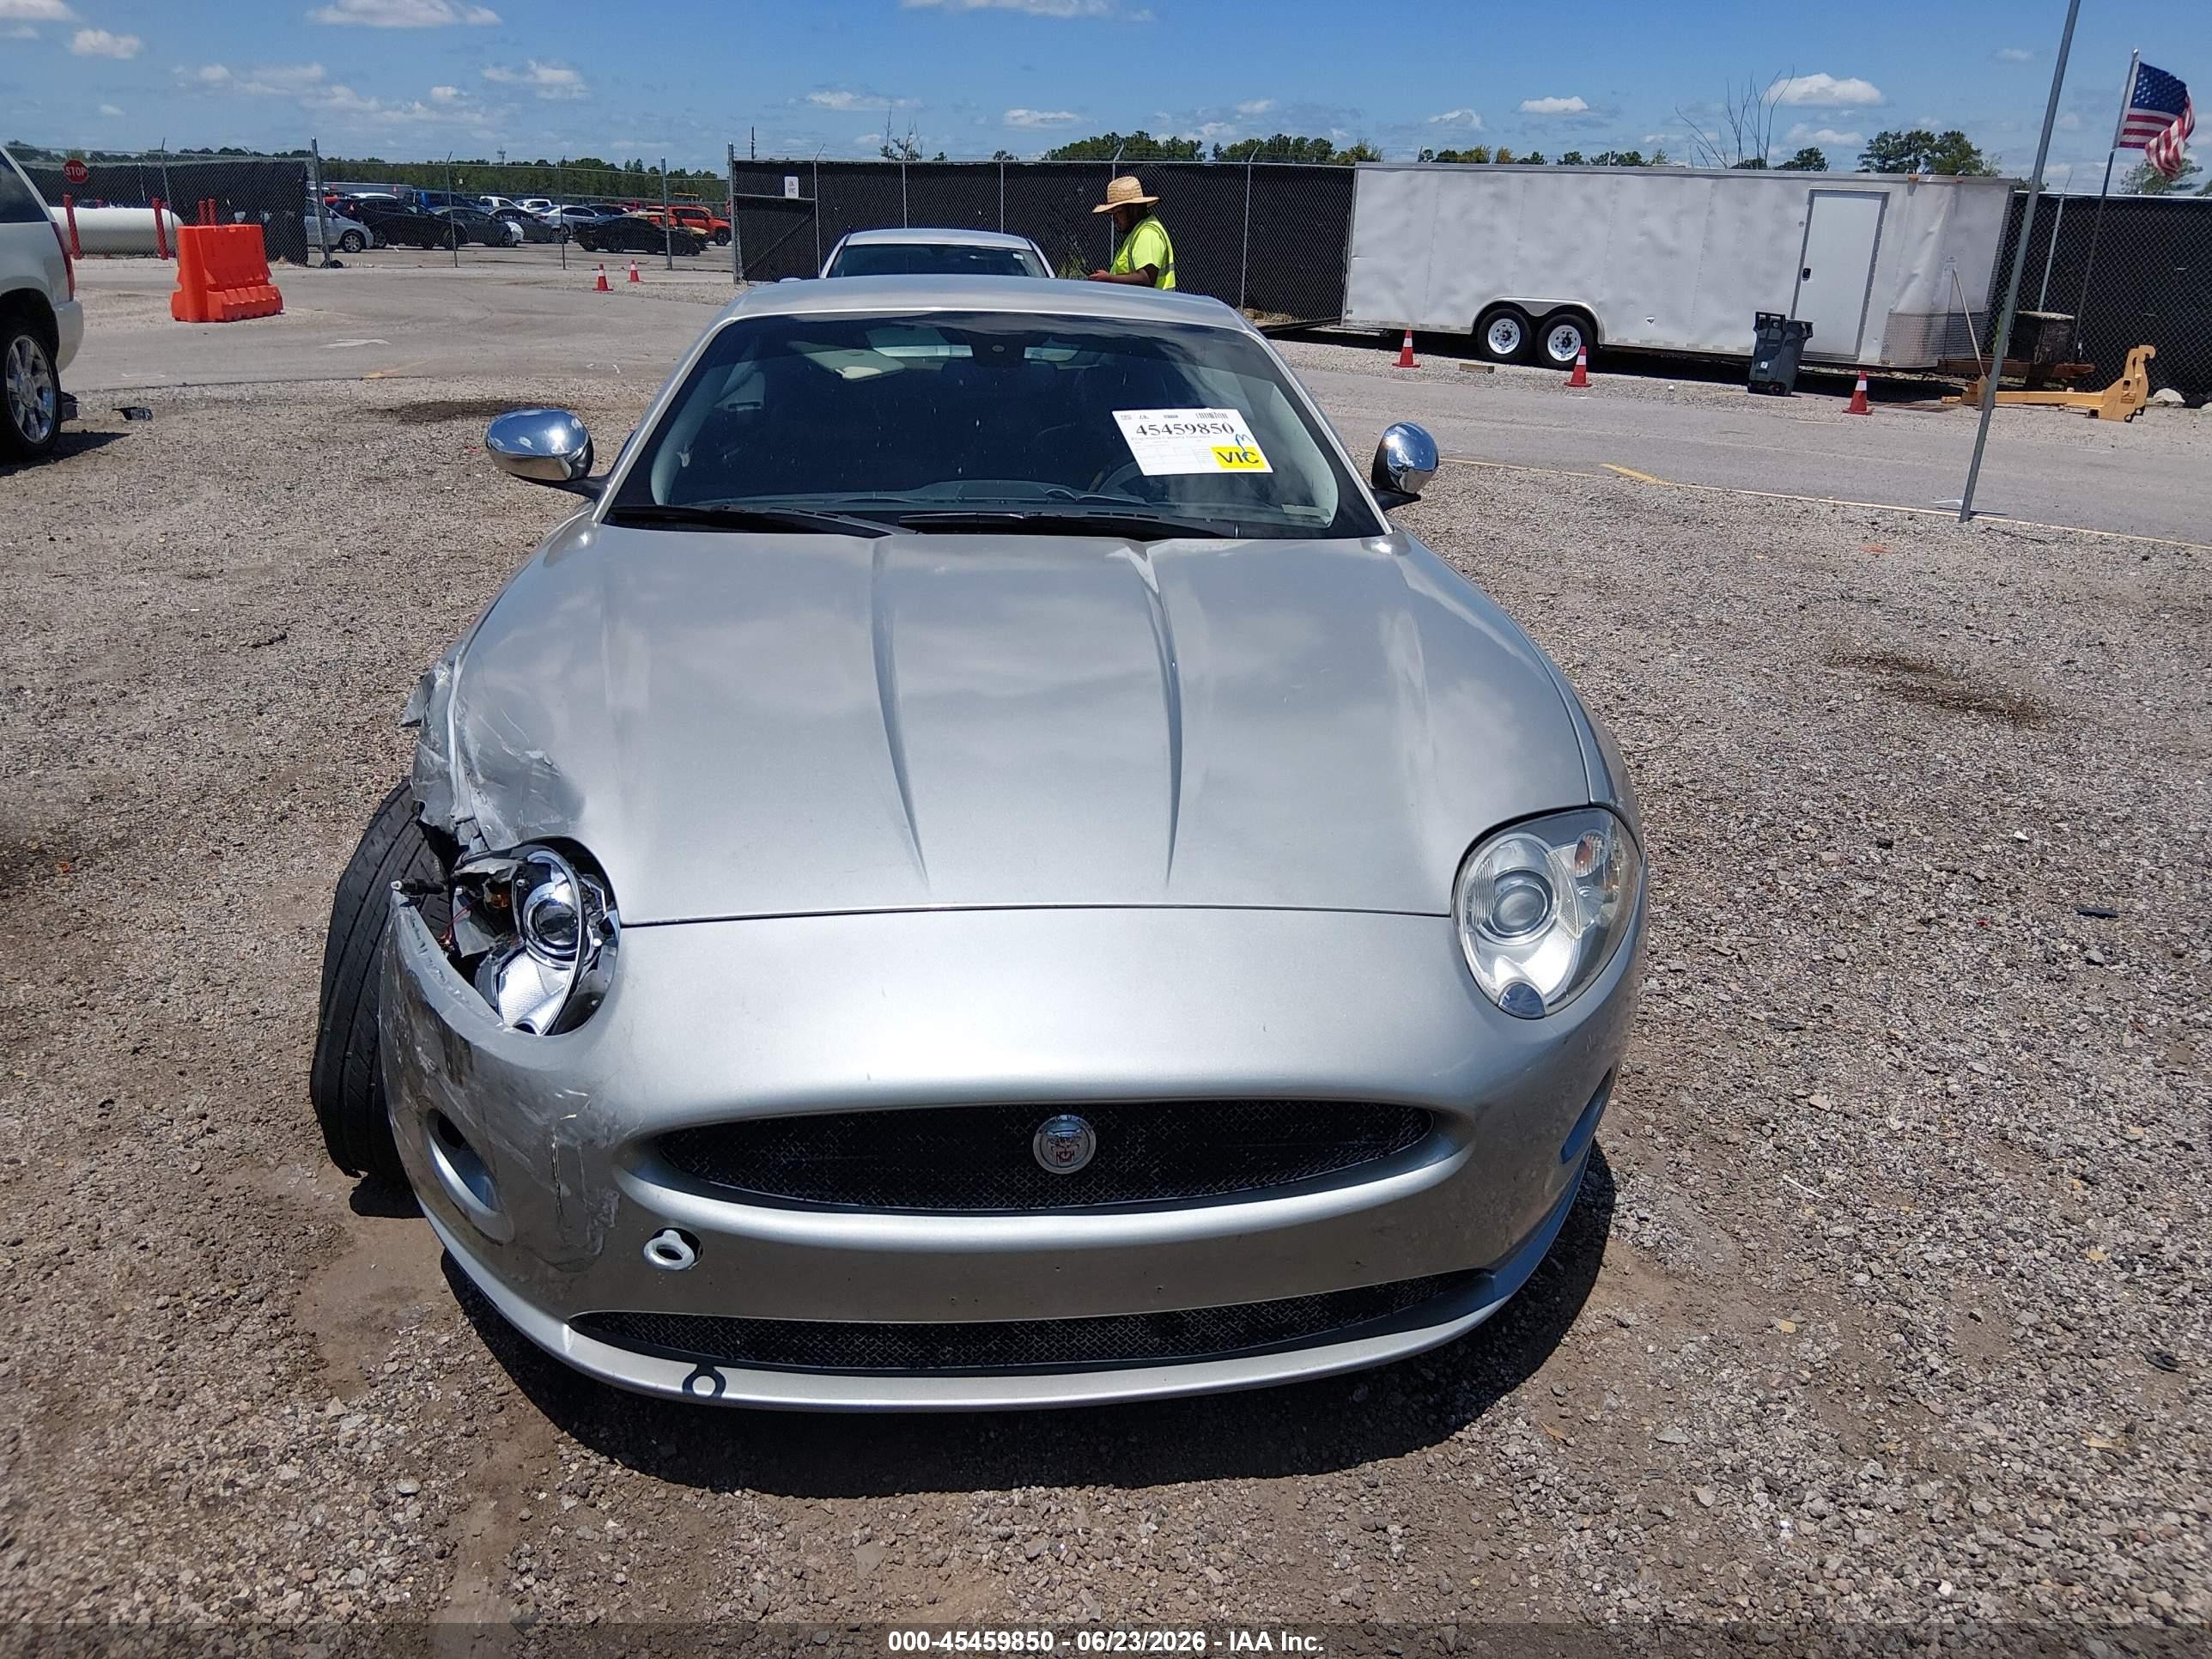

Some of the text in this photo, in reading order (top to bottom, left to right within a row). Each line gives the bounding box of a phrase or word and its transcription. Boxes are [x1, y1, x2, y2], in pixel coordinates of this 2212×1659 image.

[65, 166, 87, 177] STOP
[1136, 422, 1234, 436] 45459850
[1217, 451, 1260, 464] VIC
